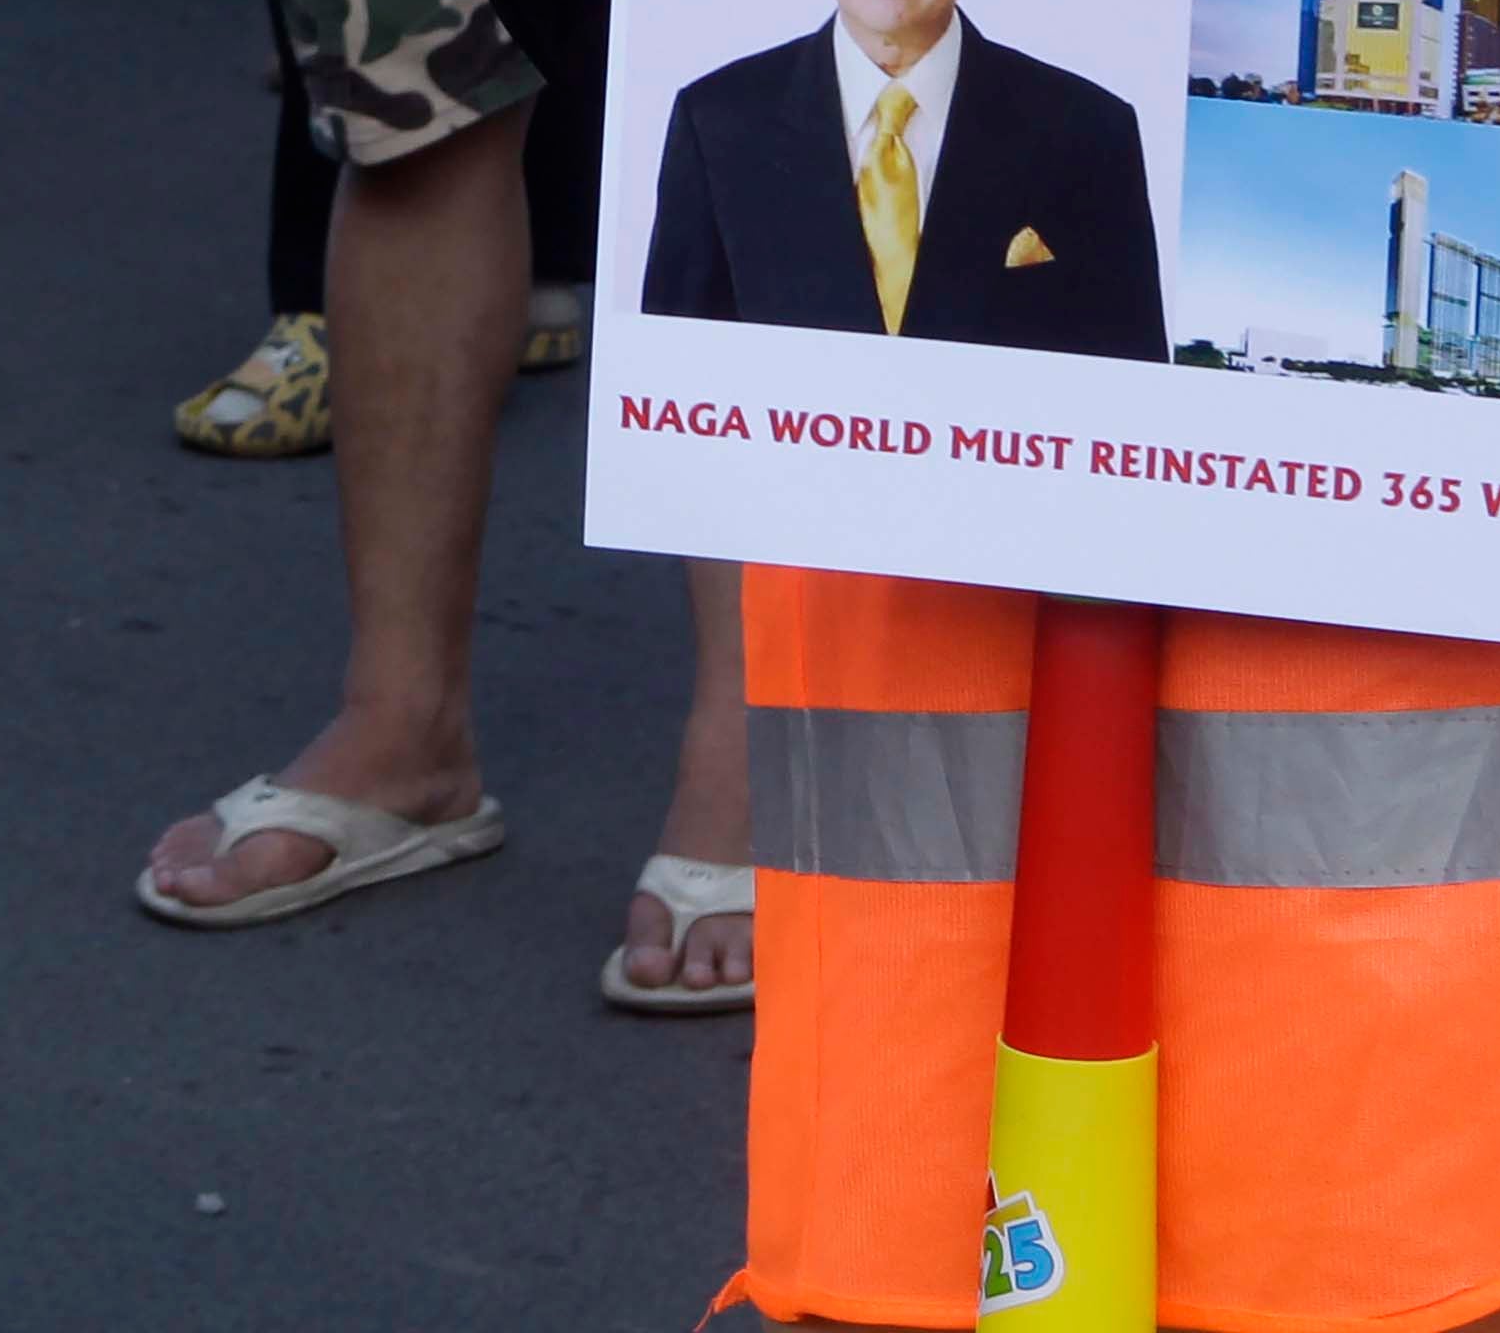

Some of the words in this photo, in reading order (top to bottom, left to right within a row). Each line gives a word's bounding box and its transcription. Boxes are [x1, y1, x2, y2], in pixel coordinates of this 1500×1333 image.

[620, 395, 751, 440] NAGA
[767, 408, 932, 456] WORLD
[950, 425, 1074, 471] MUST
[1090, 440, 1362, 502] REINSTATED
[1381, 472, 1462, 513] 365
